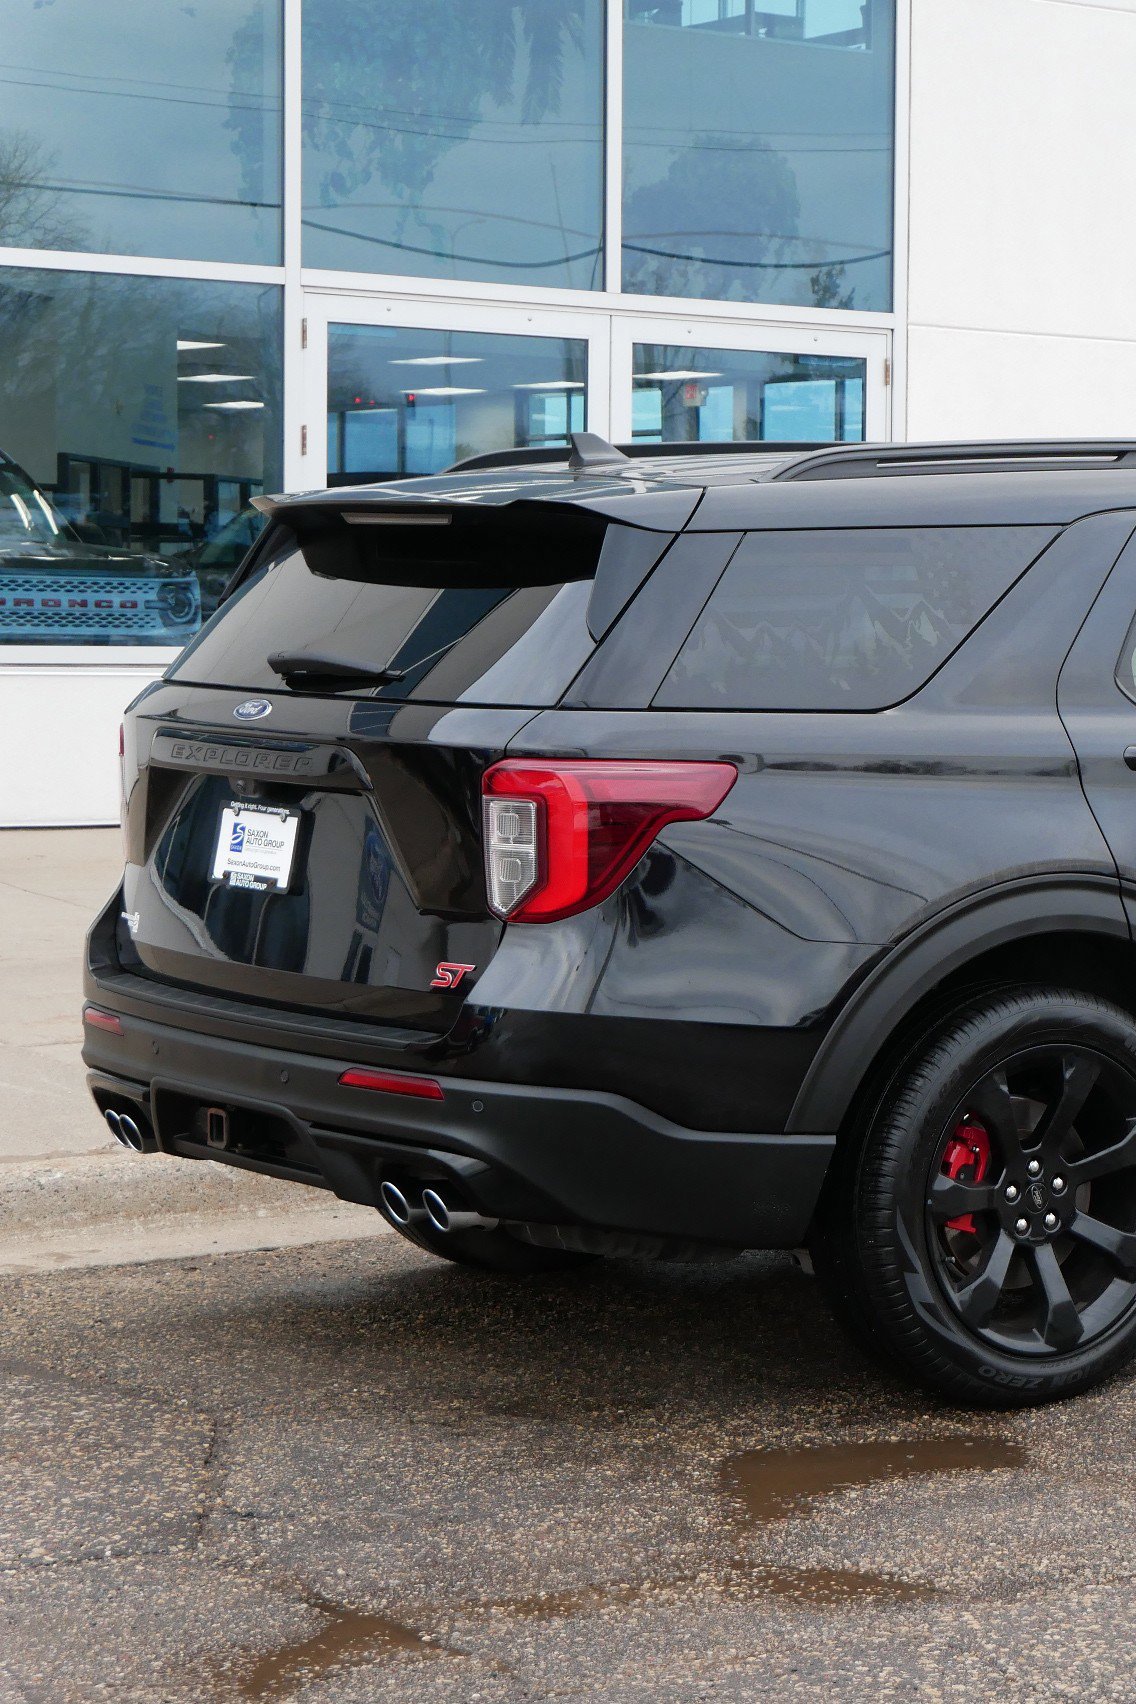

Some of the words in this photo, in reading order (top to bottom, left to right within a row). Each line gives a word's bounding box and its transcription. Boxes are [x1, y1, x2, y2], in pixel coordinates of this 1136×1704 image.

[238, 701, 263, 715] Ford
[170, 743, 314, 771] EXPLORER
[247, 828, 269, 839] SAXON
[245, 837, 263, 846] AUTO
[263, 839, 285, 849] GROUP
[227, 858, 281, 872] SaxonAutoGroup.com
[237, 872, 255, 882] SAXON
[235, 879, 250, 888] AUTO
[249, 881, 268, 890] GROUP
[430, 961, 476, 989] ST
